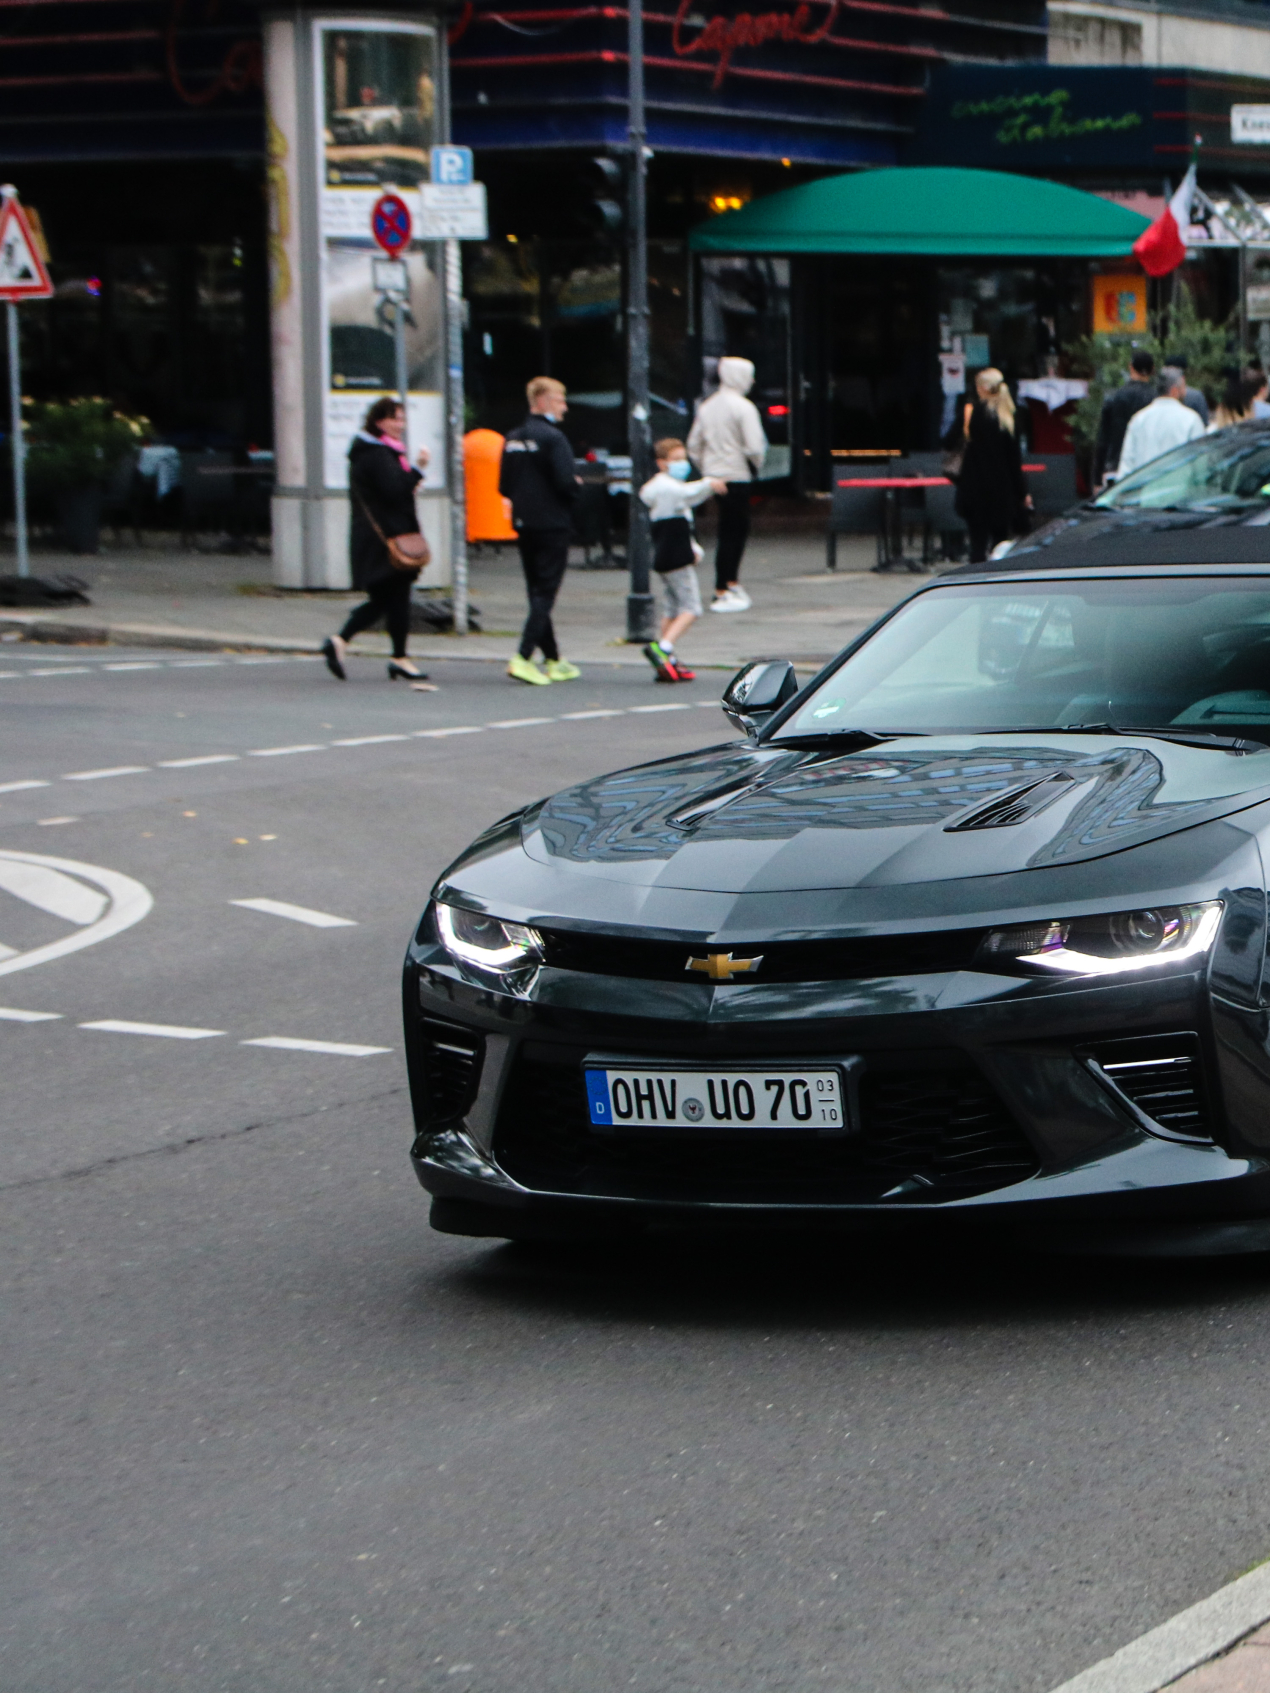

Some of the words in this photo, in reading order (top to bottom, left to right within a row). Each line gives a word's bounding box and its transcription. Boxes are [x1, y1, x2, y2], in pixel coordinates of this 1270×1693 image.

[439, 152, 463, 182] P
[816, 1079, 835, 1092] 03
[611, 1077, 677, 1120] OHV
[707, 1078, 756, 1121] UO
[764, 1078, 813, 1121] 70
[596, 1102, 605, 1114] D
[820, 1108, 838, 1121] 10
